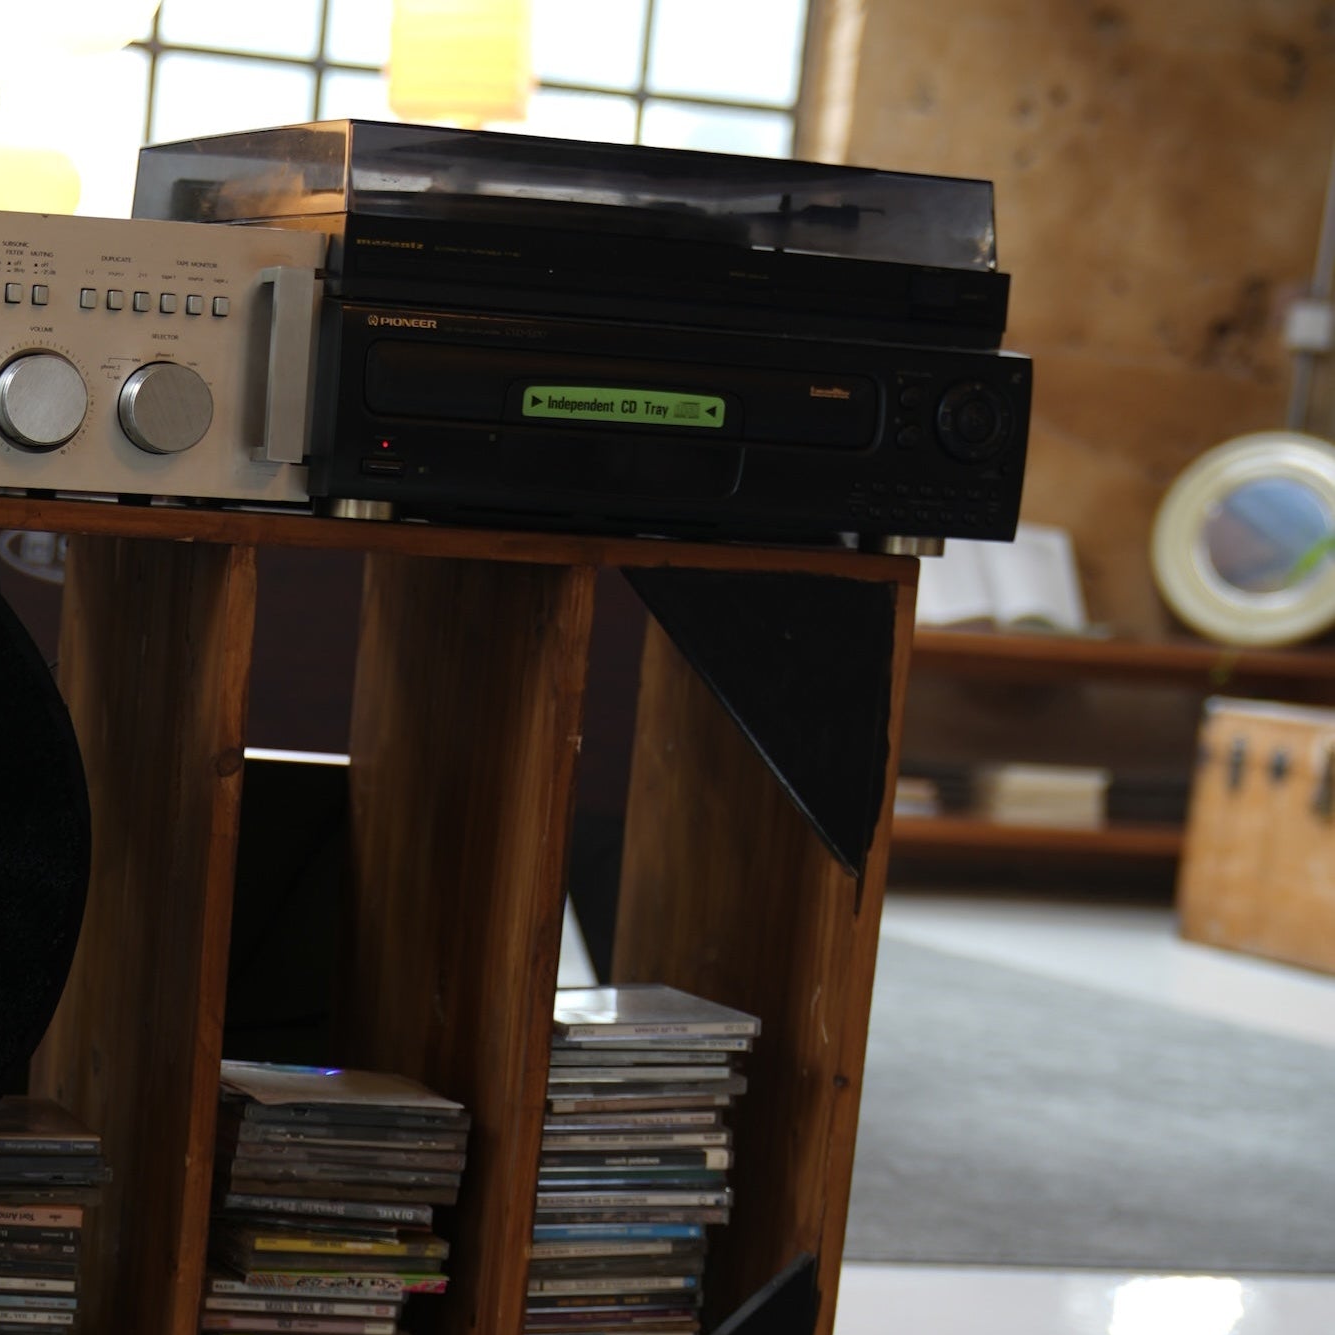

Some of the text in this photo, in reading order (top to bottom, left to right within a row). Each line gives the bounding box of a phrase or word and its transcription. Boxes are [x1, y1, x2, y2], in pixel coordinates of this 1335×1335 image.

[380, 317, 438, 330] PIONEER
[547, 394, 669, 418] Independent CD Tray
